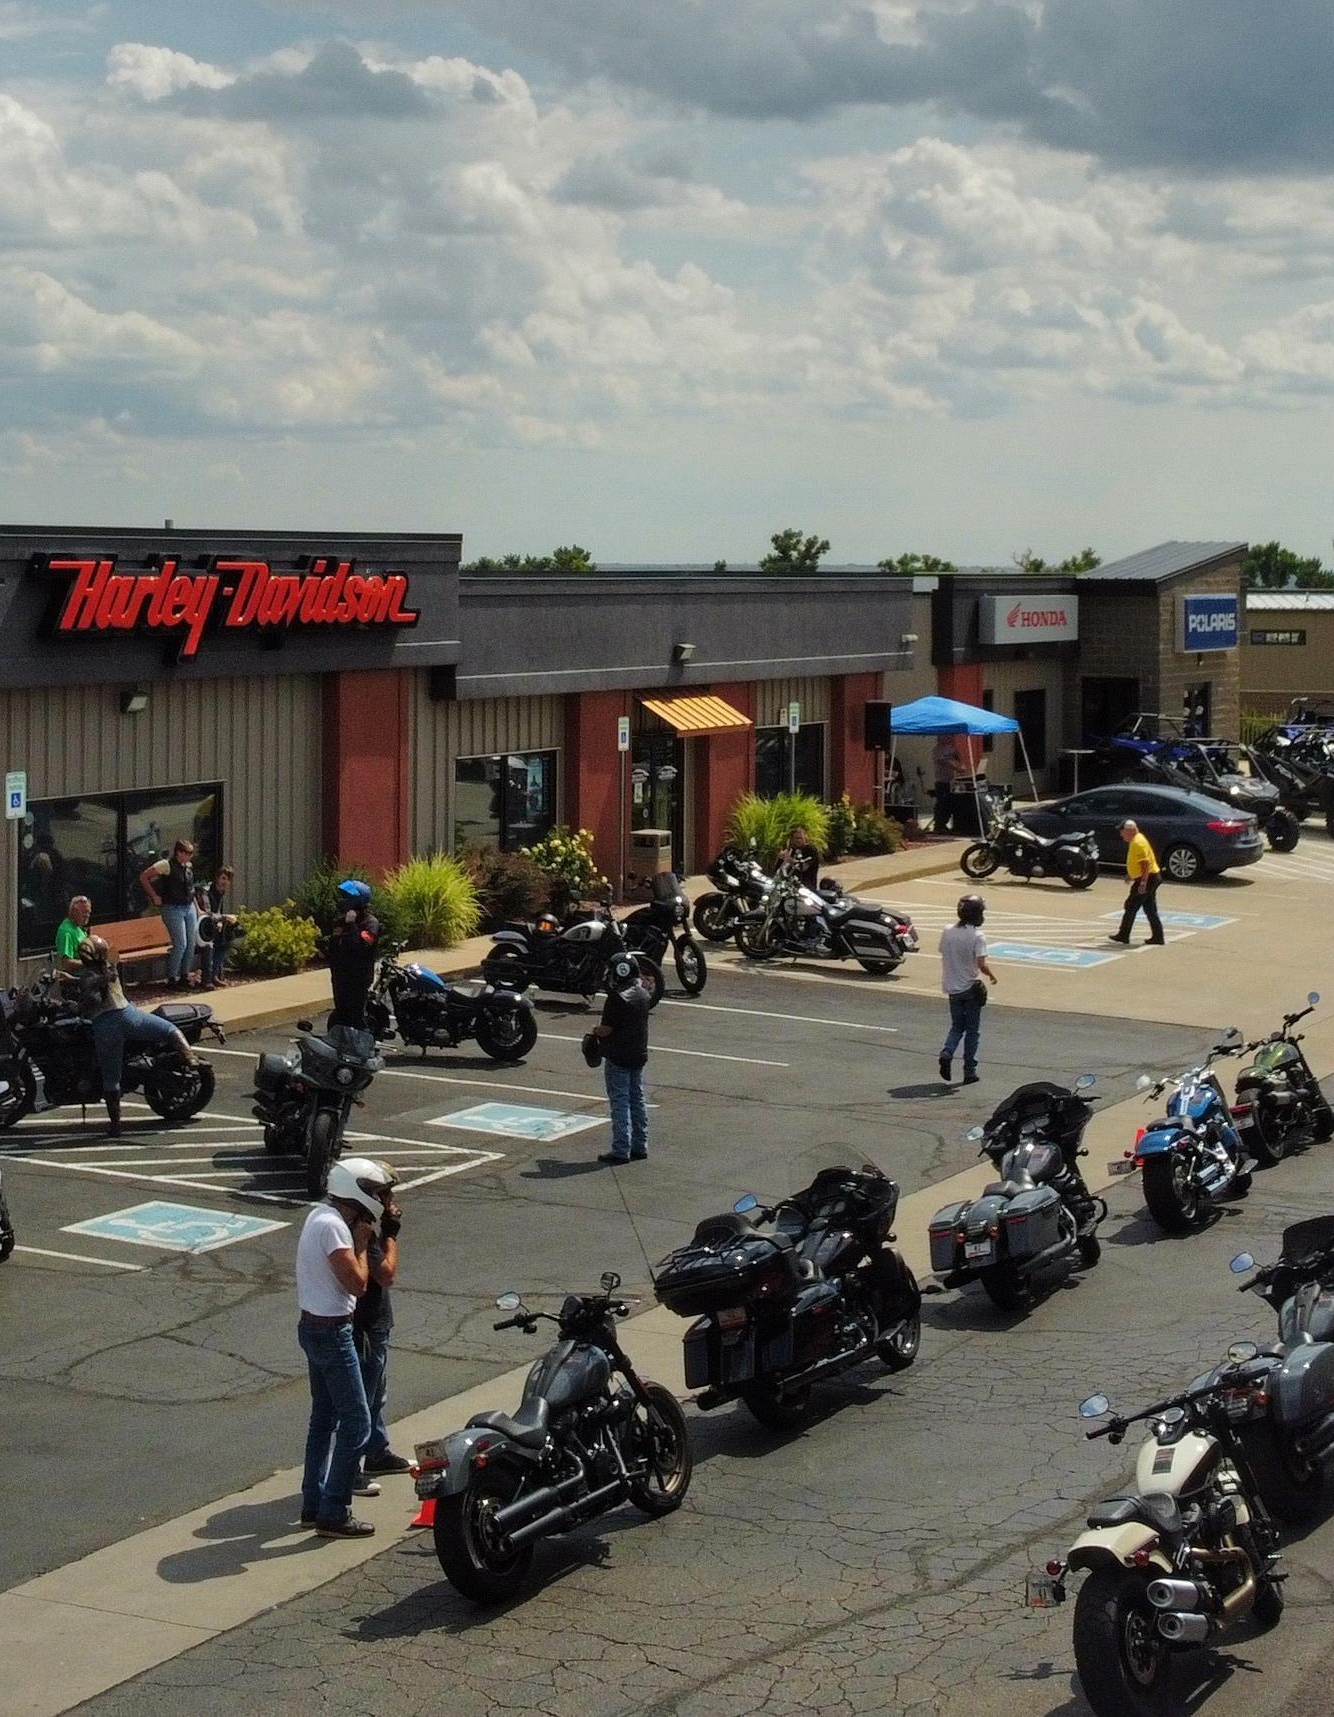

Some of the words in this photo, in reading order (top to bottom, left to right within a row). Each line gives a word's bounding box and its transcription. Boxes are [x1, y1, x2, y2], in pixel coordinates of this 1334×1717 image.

[49, 560, 418, 655] Harley-Davidson
[1020, 610, 1068, 627] HONDA
[1188, 612, 1236, 633] POLARIS
